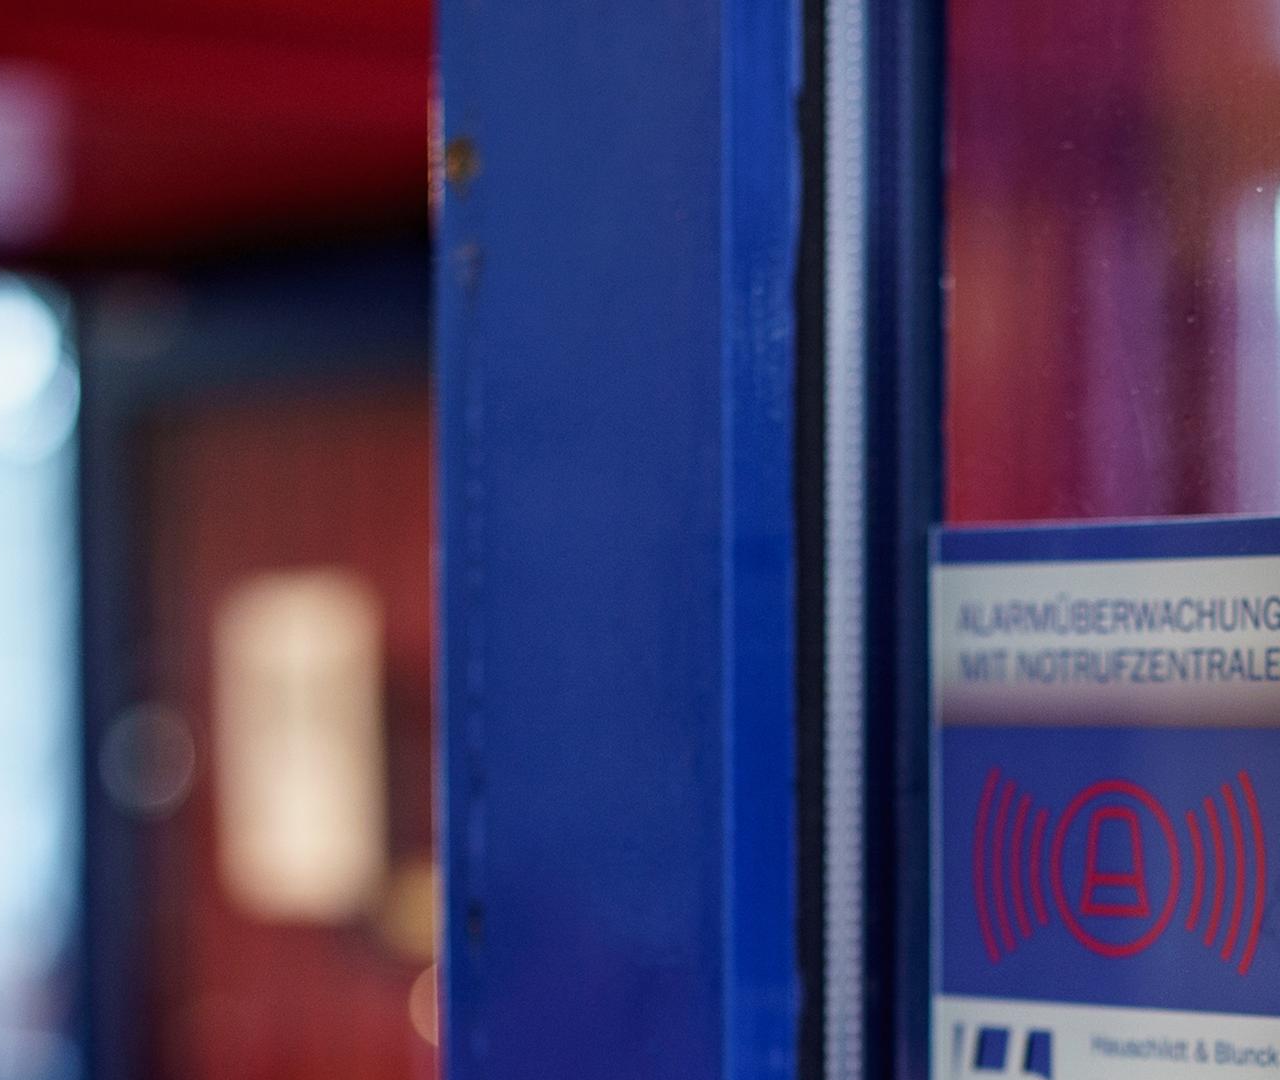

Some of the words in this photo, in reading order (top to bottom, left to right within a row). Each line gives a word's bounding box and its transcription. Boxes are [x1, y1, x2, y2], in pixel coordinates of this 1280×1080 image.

[959, 648, 1008, 682] MIT
[1195, 1037, 1209, 1064] &
[1214, 1038, 1280, 1068] Blunck
